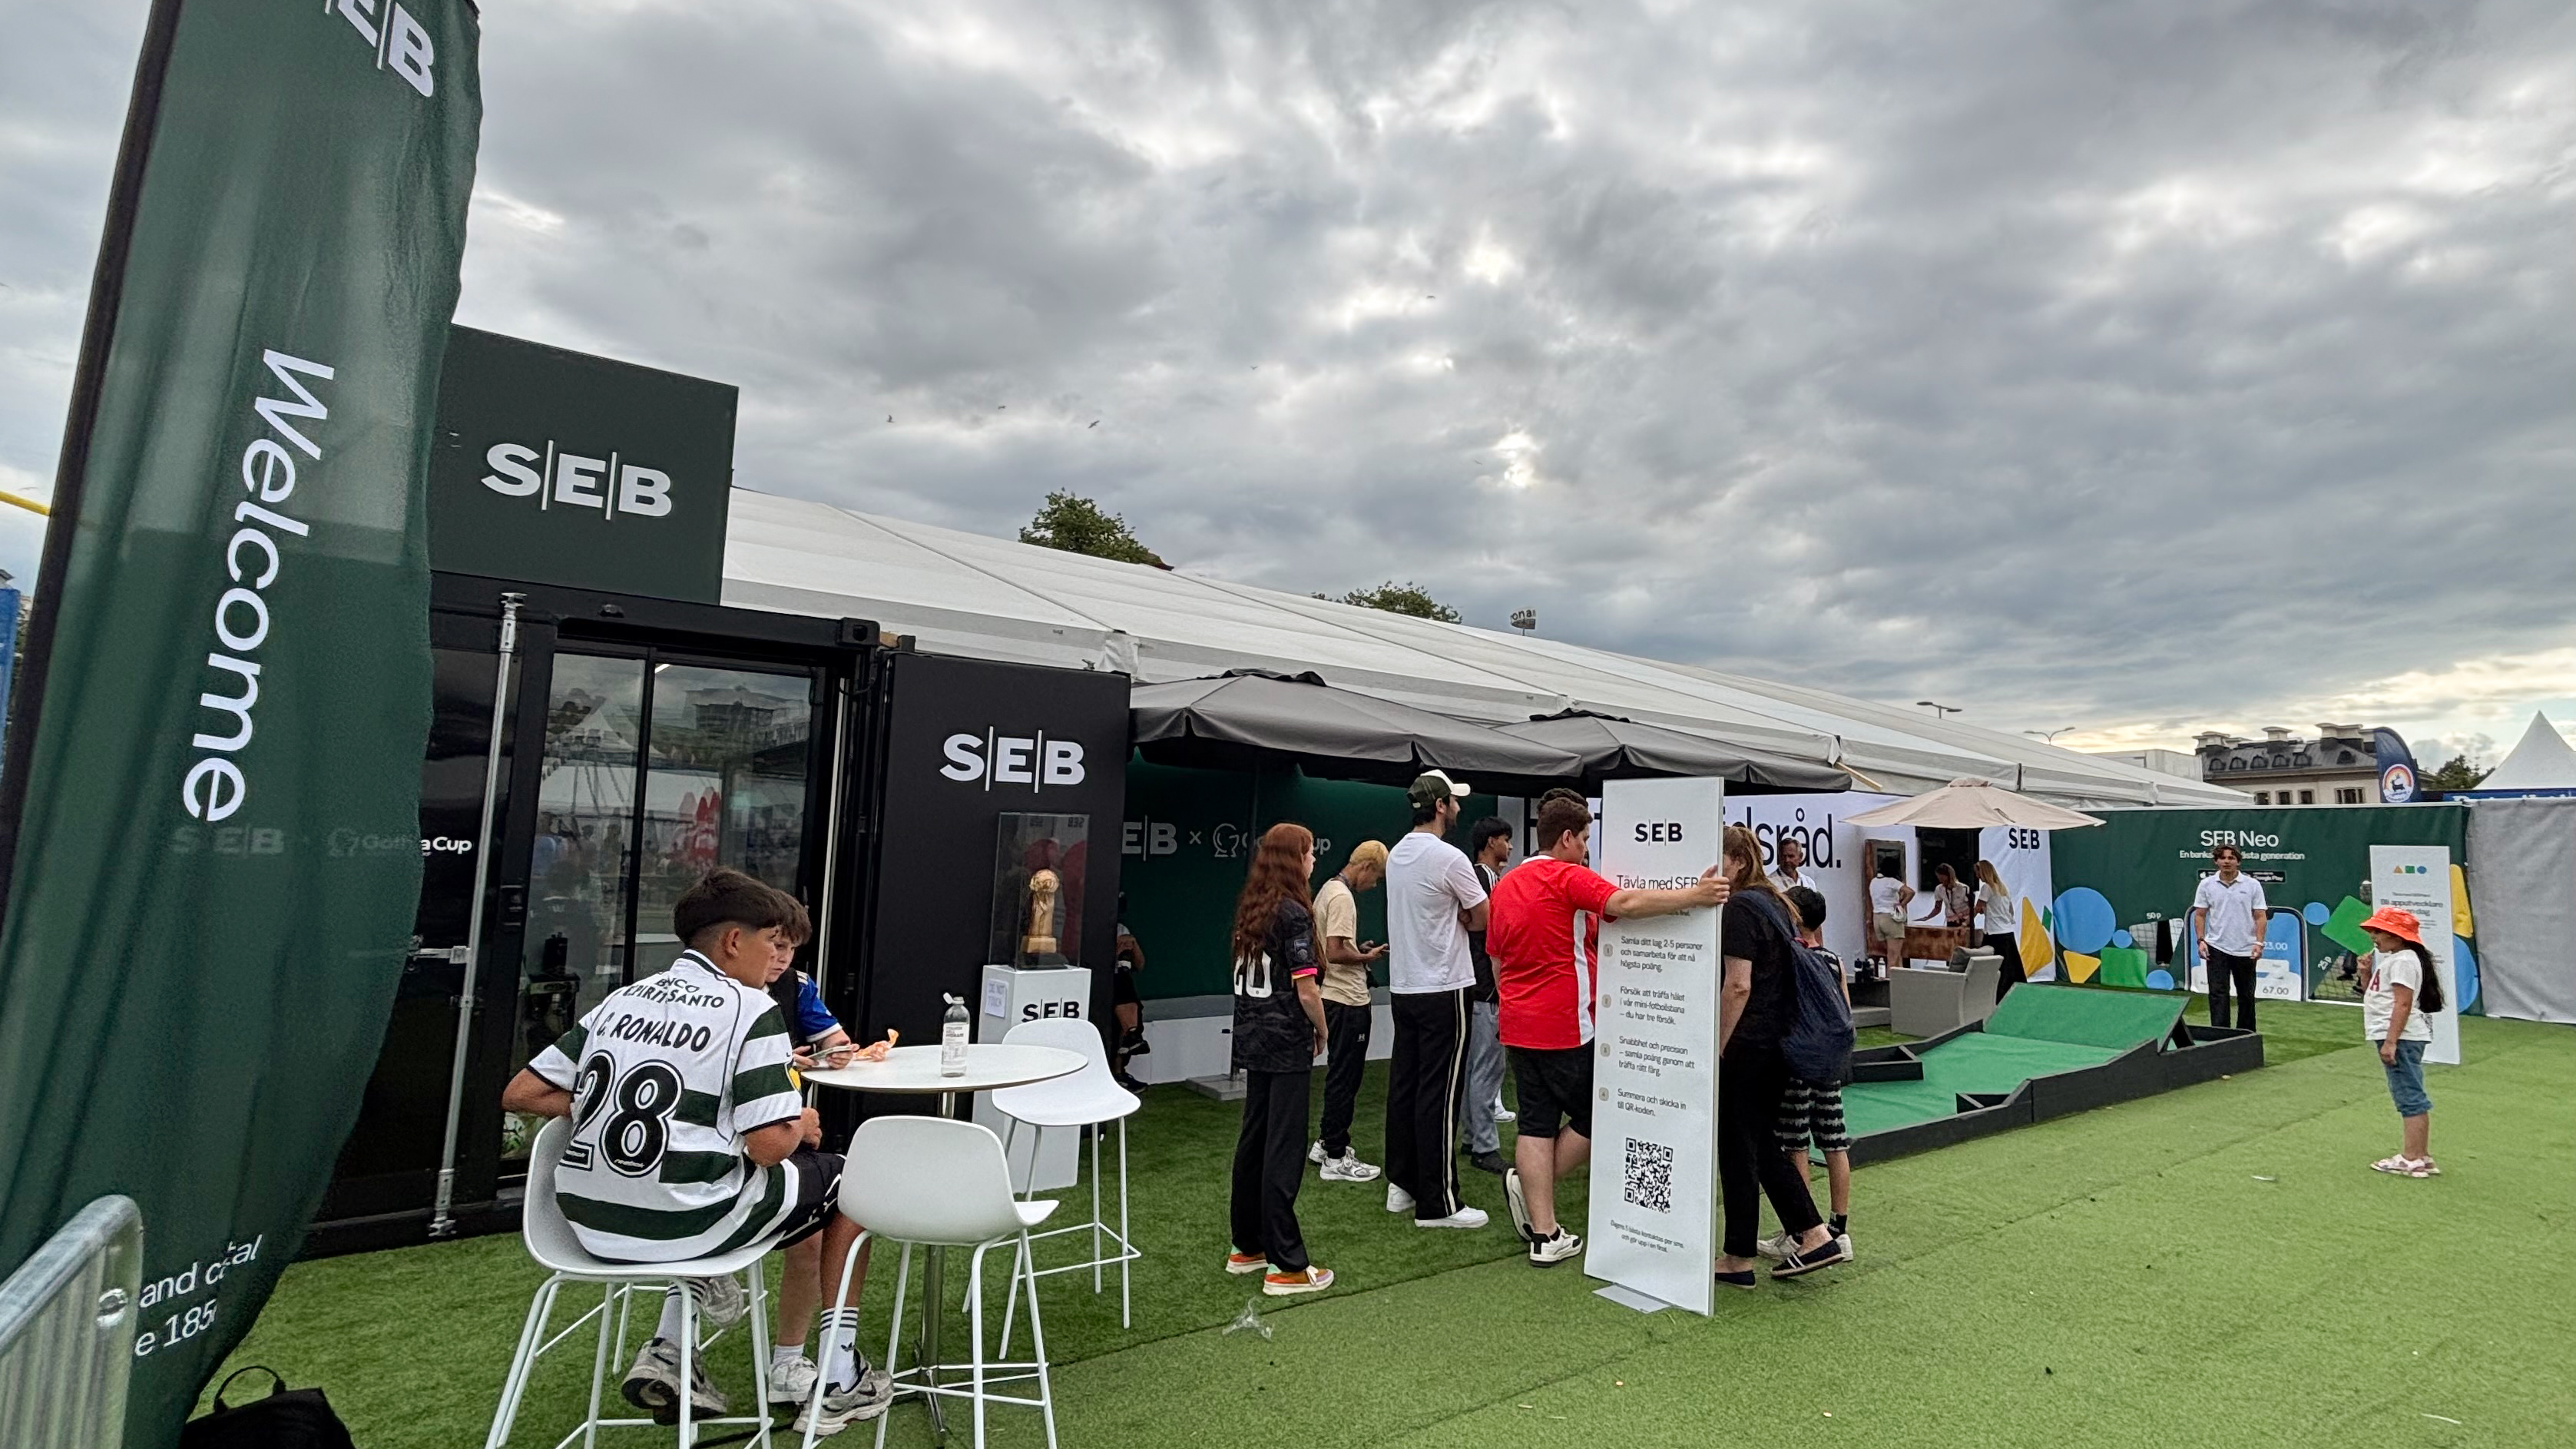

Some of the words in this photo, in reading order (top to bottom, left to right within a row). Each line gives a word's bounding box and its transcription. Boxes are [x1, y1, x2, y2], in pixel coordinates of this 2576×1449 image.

[325, 0, 434, 97] EB
[481, 440, 672, 520] SEB
[183, 349, 335, 821] Welcome
[939, 726, 1085, 793] SEB
[1121, 816, 1177, 861] EB
[1312, 837, 1331, 855] up
[1634, 819, 1683, 846] SEB
[2009, 827, 2040, 852] SEB
[2240, 831, 2279, 847] Neo
[433, 836, 472, 854] Cup
[2260, 853, 2305, 861] generation
[1616, 874, 1646, 890] Tävla
[1649, 876, 1673, 890] med
[1621, 936, 1640, 944] Samla
[1676, 941, 1703, 950] personer
[1621, 960, 1641, 970] högsta
[1633, 950, 1666, 960] samarbeta
[667, 989, 724, 1008] SANTO
[1621, 986, 1641, 996] Försök
[1653, 990, 1669, 999] träffa
[610, 1014, 711, 1053] RONALDO
[1619, 1036, 1647, 1047] Snabbhet
[1660, 1044, 1688, 1055] precision
[1617, 1088, 1645, 1102] Summera
[1646, 1096, 1657, 1105] och
[1659, 1098, 1679, 1109] skicka
[1680, 1101, 1686, 1109] in
[559, 1049, 685, 1178] 28
[140, 1261, 198, 1308] and
